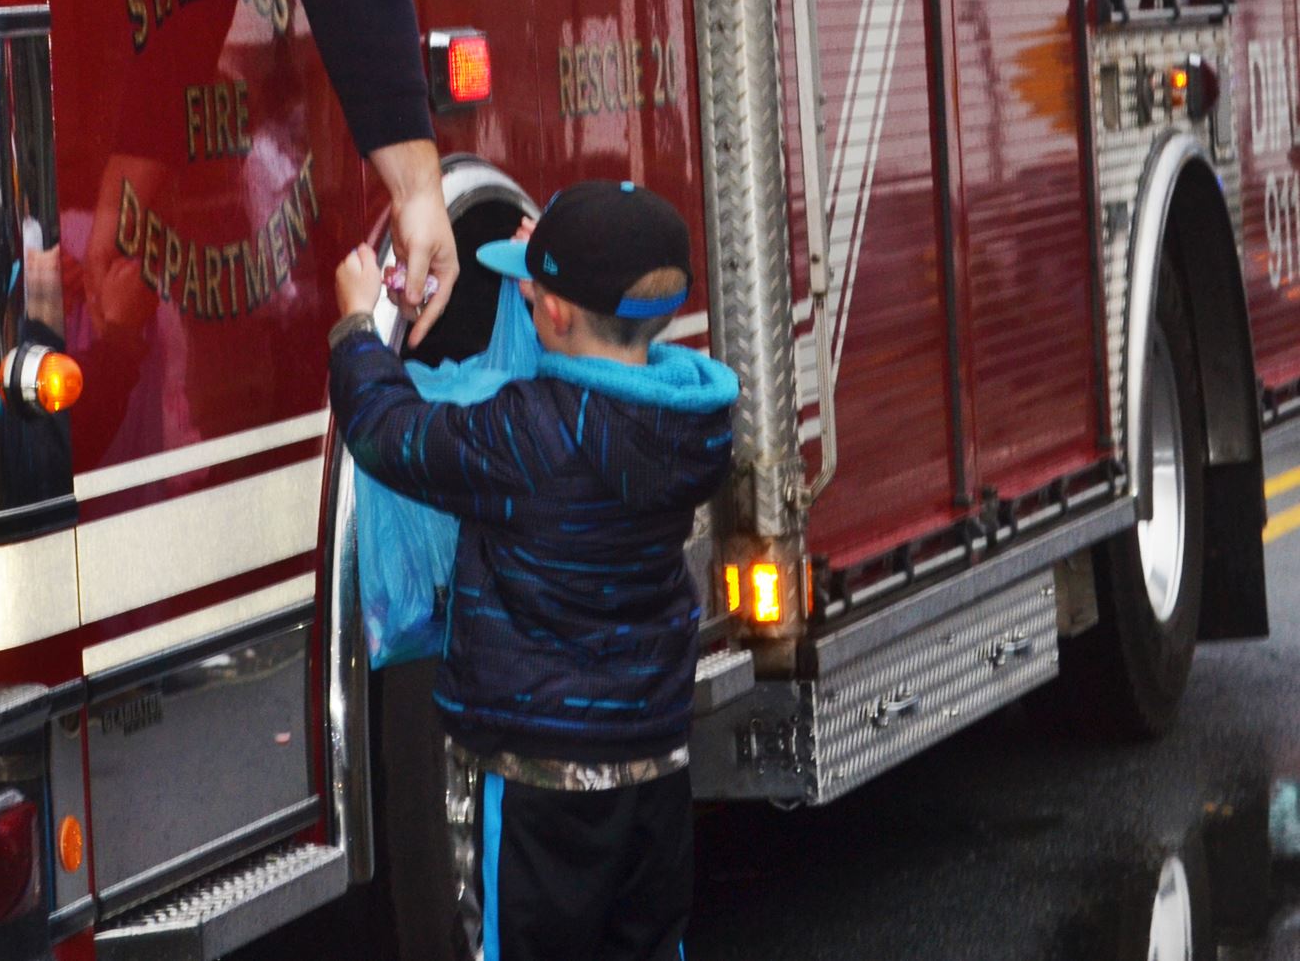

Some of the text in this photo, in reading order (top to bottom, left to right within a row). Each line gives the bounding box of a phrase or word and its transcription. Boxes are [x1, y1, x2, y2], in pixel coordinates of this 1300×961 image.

[558, 34, 679, 119] RESCUE 20
[186, 79, 252, 161] FIRE
[116, 147, 320, 321] DEPARTMENT
